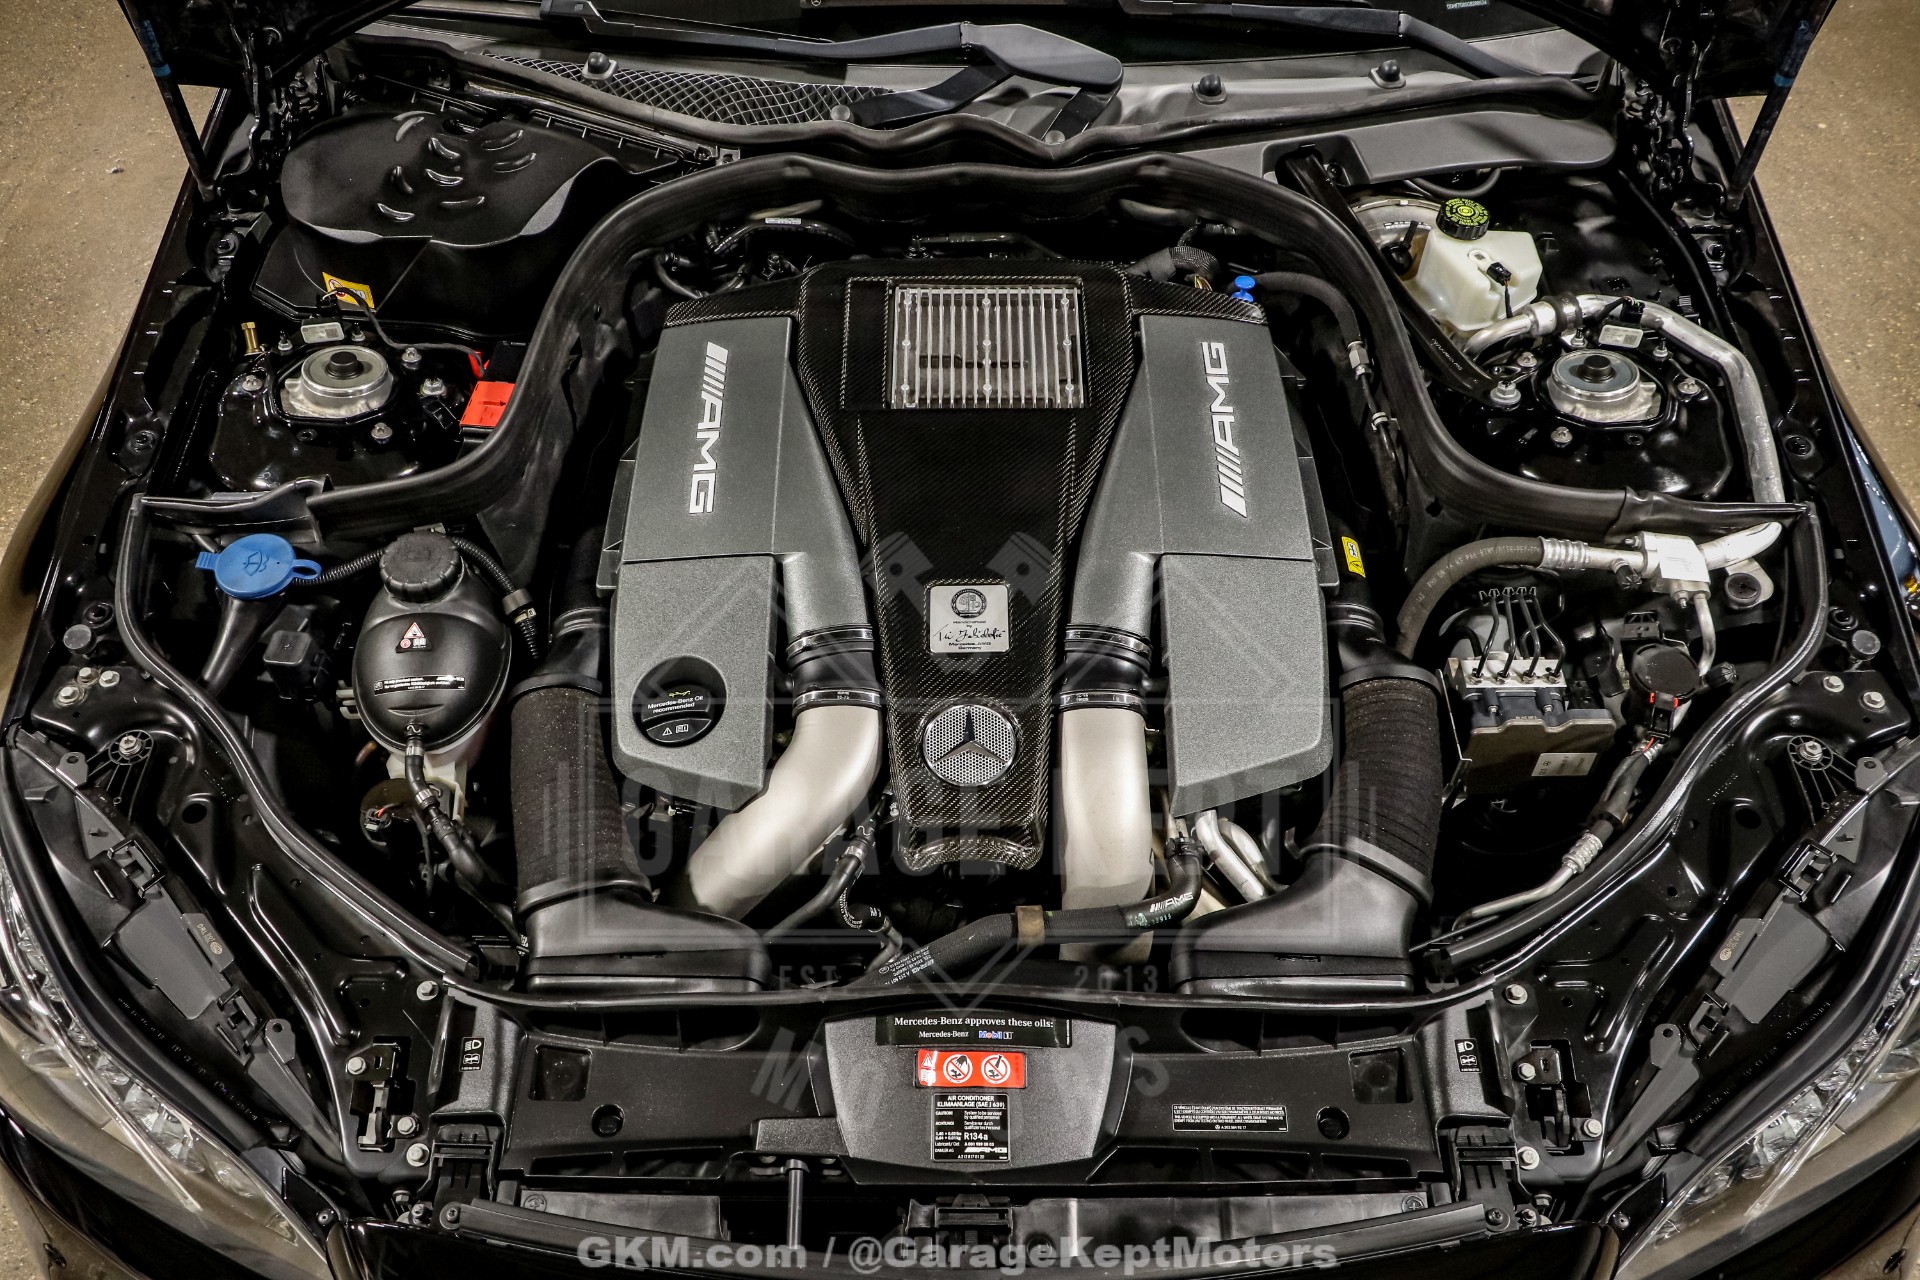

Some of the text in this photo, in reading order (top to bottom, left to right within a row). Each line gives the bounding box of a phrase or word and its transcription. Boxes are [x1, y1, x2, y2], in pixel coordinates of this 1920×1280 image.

[1201, 341, 1241, 460] AMG
[689, 388, 724, 514] AMG
[647, 696, 694, 710] Mercedes-Benz
[652, 702, 695, 714] recommended
[894, 1016, 1054, 1028] Mercedes-Benz approves these oils:
[918, 1030, 970, 1038] Mercedes-Benz
[978, 1031, 1003, 1039] Mobil
[964, 1132, 989, 1141] R134a
